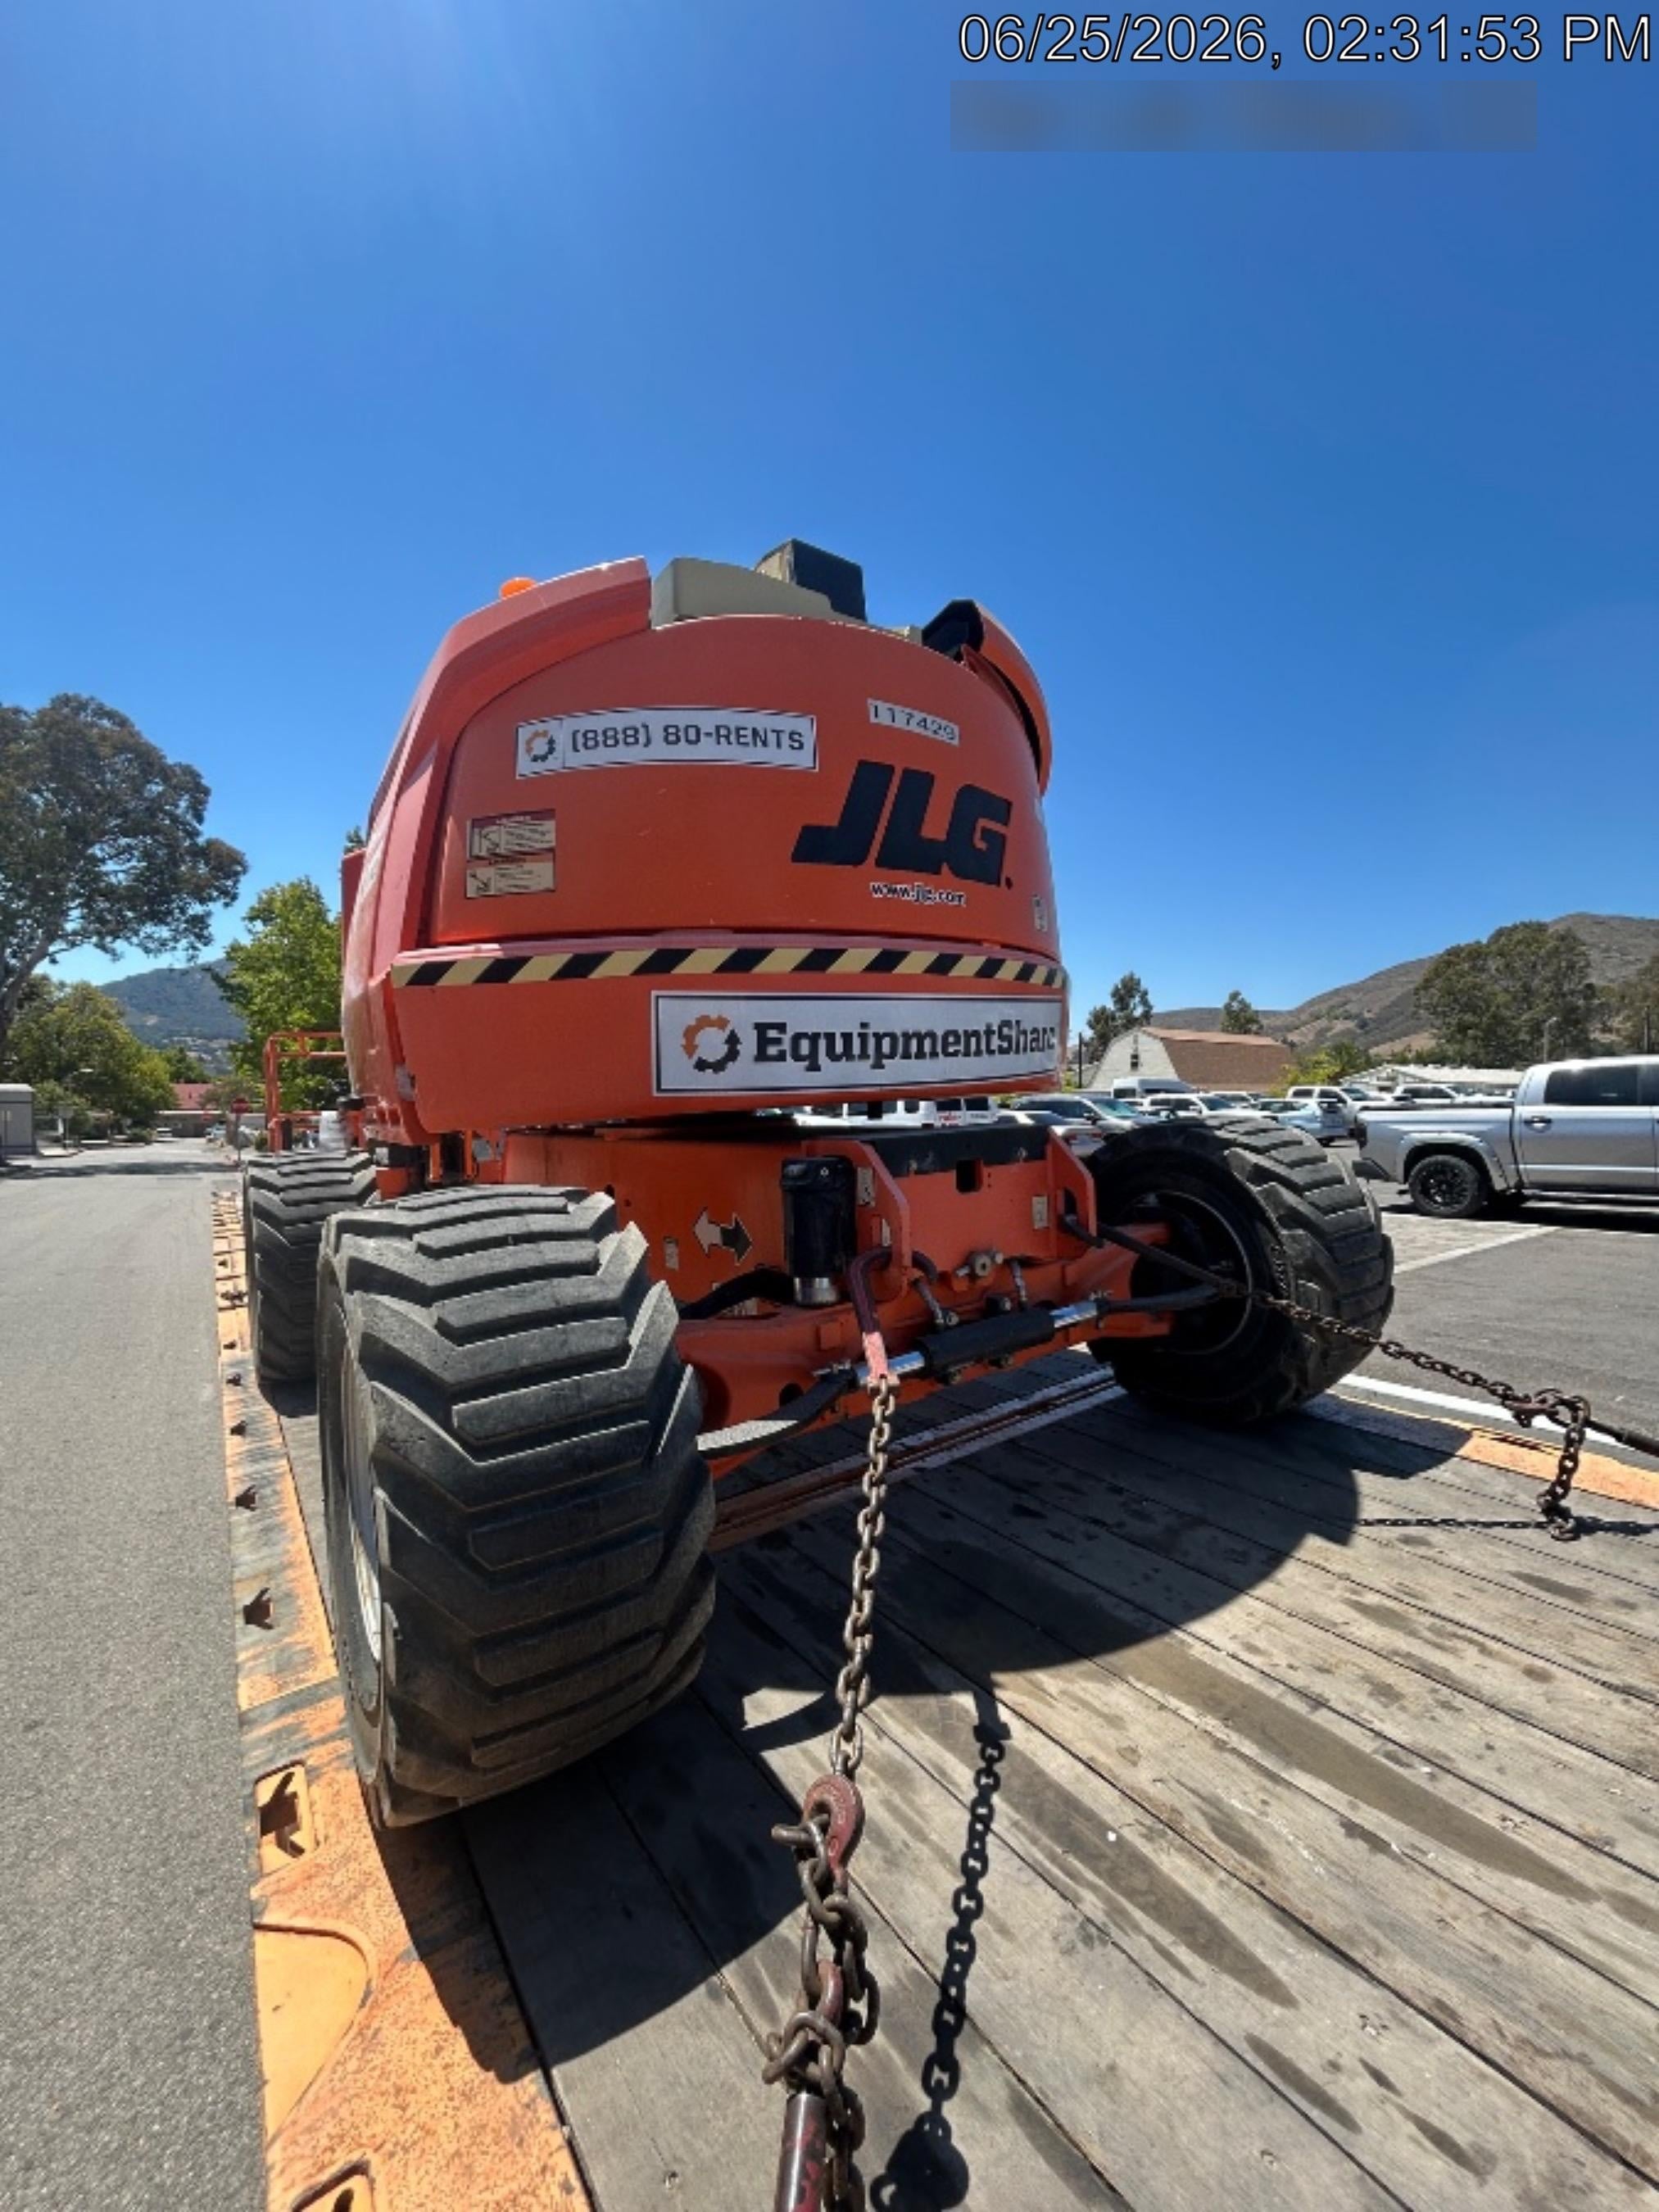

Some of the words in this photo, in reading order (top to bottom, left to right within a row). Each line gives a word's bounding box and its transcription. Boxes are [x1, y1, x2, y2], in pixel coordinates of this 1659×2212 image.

[571, 722, 652, 753] (888)
[663, 724, 805, 751] 80-RENTS
[873, 704, 955, 741] 117429
